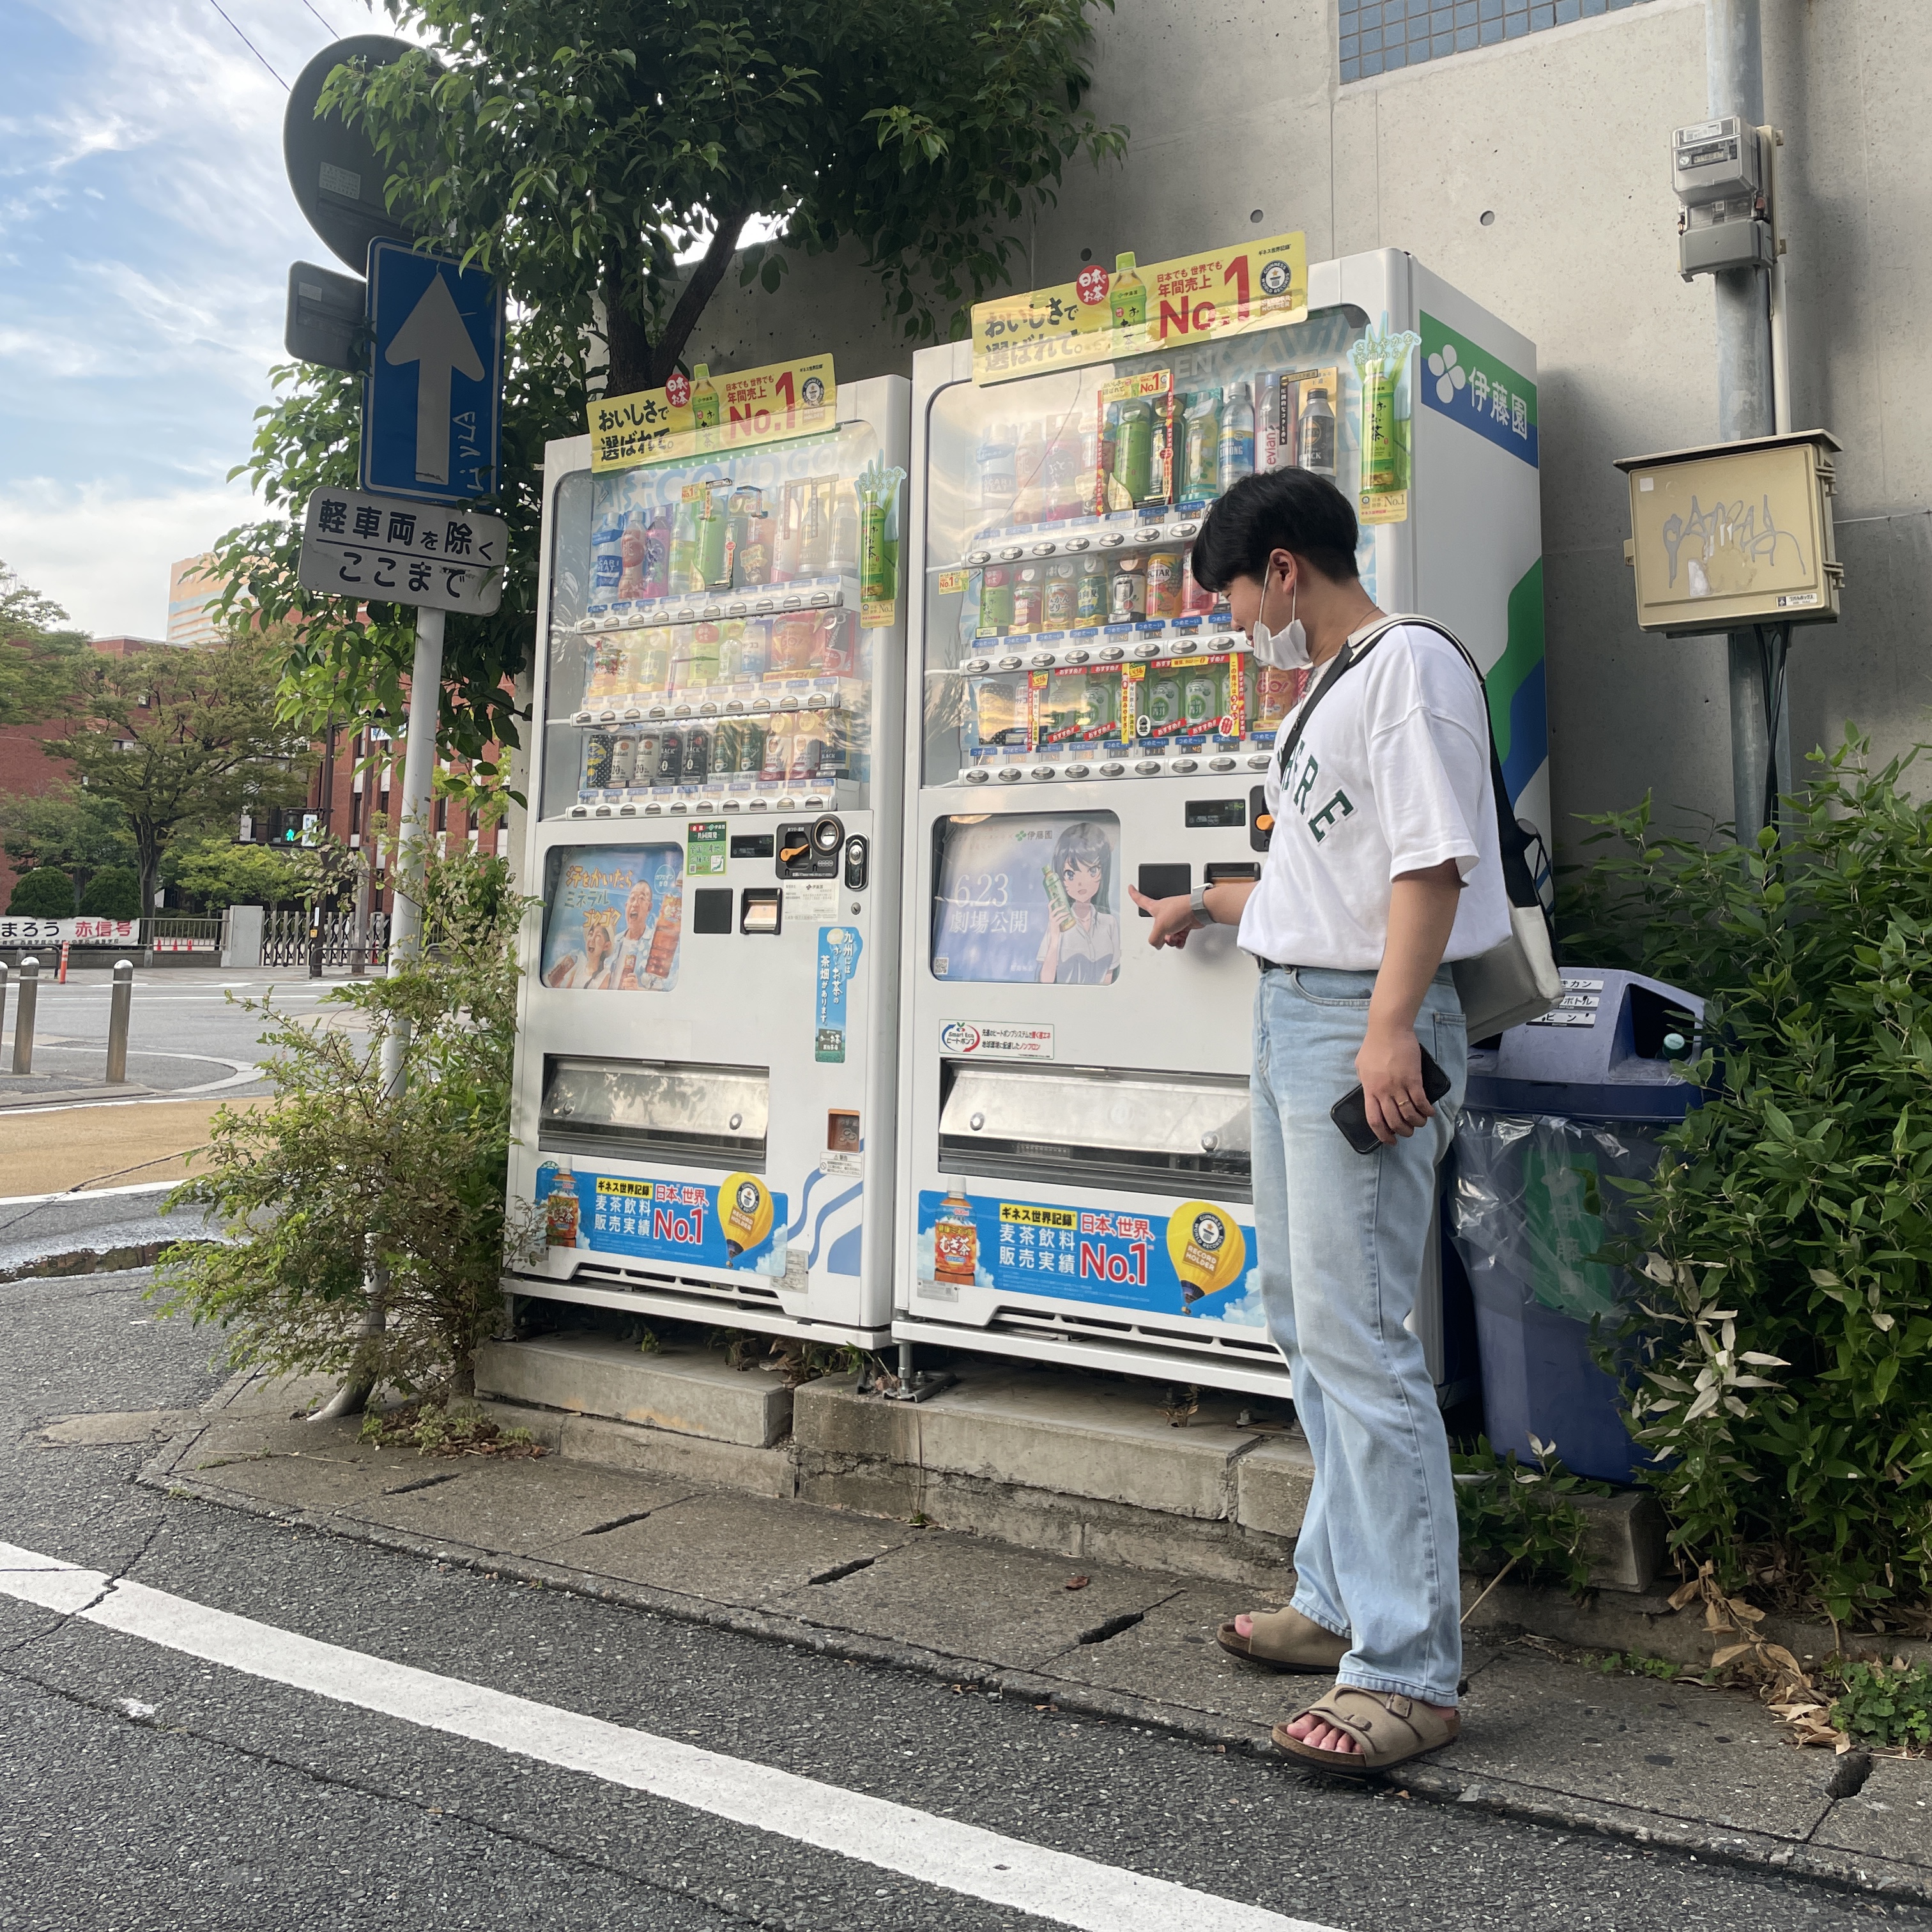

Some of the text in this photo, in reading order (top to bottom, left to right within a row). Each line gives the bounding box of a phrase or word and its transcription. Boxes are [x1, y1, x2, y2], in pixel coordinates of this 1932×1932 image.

[1157, 261, 1223, 283] 日本でも 世界でも
[1158, 274, 1212, 298] 年間売上
[1160, 254, 1250, 339] No.1
[985, 297, 1078, 337] おいしさで
[726, 375, 774, 391] 日本でも 世界でも
[1140, 372, 1159, 394] No.1
[727, 386, 767, 404] 年間売上
[729, 371, 795, 440] No.1
[1469, 367, 1528, 440] 伊藤園
[599, 399, 670, 432] おいしさで
[601, 427, 673, 461] 選ばれて。
[1266, 431, 1276, 465] evian
[682, 487, 693, 499] No.1
[1384, 494, 1406, 507] No.1
[318, 498, 494, 562] 軽車両を除く
[339, 551, 465, 598] ここまで
[939, 576, 954, 588] No.1
[878, 599, 893, 613] No.1
[1095, 664, 1119, 672] おすすめ!!
[1053, 726, 1075, 740] おすすめ!!
[1088, 724, 1111, 739] おすすめ!!
[1157, 721, 1181, 735] おすすめ!!
[1193, 720, 1216, 734] おすすめ!!
[1027, 830, 1053, 840] 伊藤園
[565, 865, 633, 888] 汗をかいたら
[564, 889, 610, 908] ミネラル
[954, 873, 1009, 908] 6.23
[583, 907, 622, 928] ゴクゴク
[949, 910, 1029, 935] 劇場公開
[1, 921, 132, 937] まろう 赤信号
[843, 931, 854, 974] 九州には
[820, 954, 831, 1027] 茶畑があります。
[597, 1180, 650, 1197] ギネス世界記録
[595, 1194, 651, 1217] 麦茶飲料
[594, 1213, 650, 1237] 販売実績
[654, 1208, 703, 1245] No.1
[730, 1216, 752, 1232] HOLDER
[732, 1209, 754, 1225] RECORD
[1002, 1207, 1073, 1227] ギネス世界記録
[1081, 1213, 1155, 1241] 日本、世界、
[939, 1234, 972, 1256] むぎ茶
[999, 1223, 1075, 1252] 麦茶飲料
[999, 1245, 1076, 1275] 販売実績
[1080, 1241, 1147, 1287] No.1
[1184, 1252, 1216, 1272] HOLDER
[1186, 1245, 1218, 1266] RECORD
